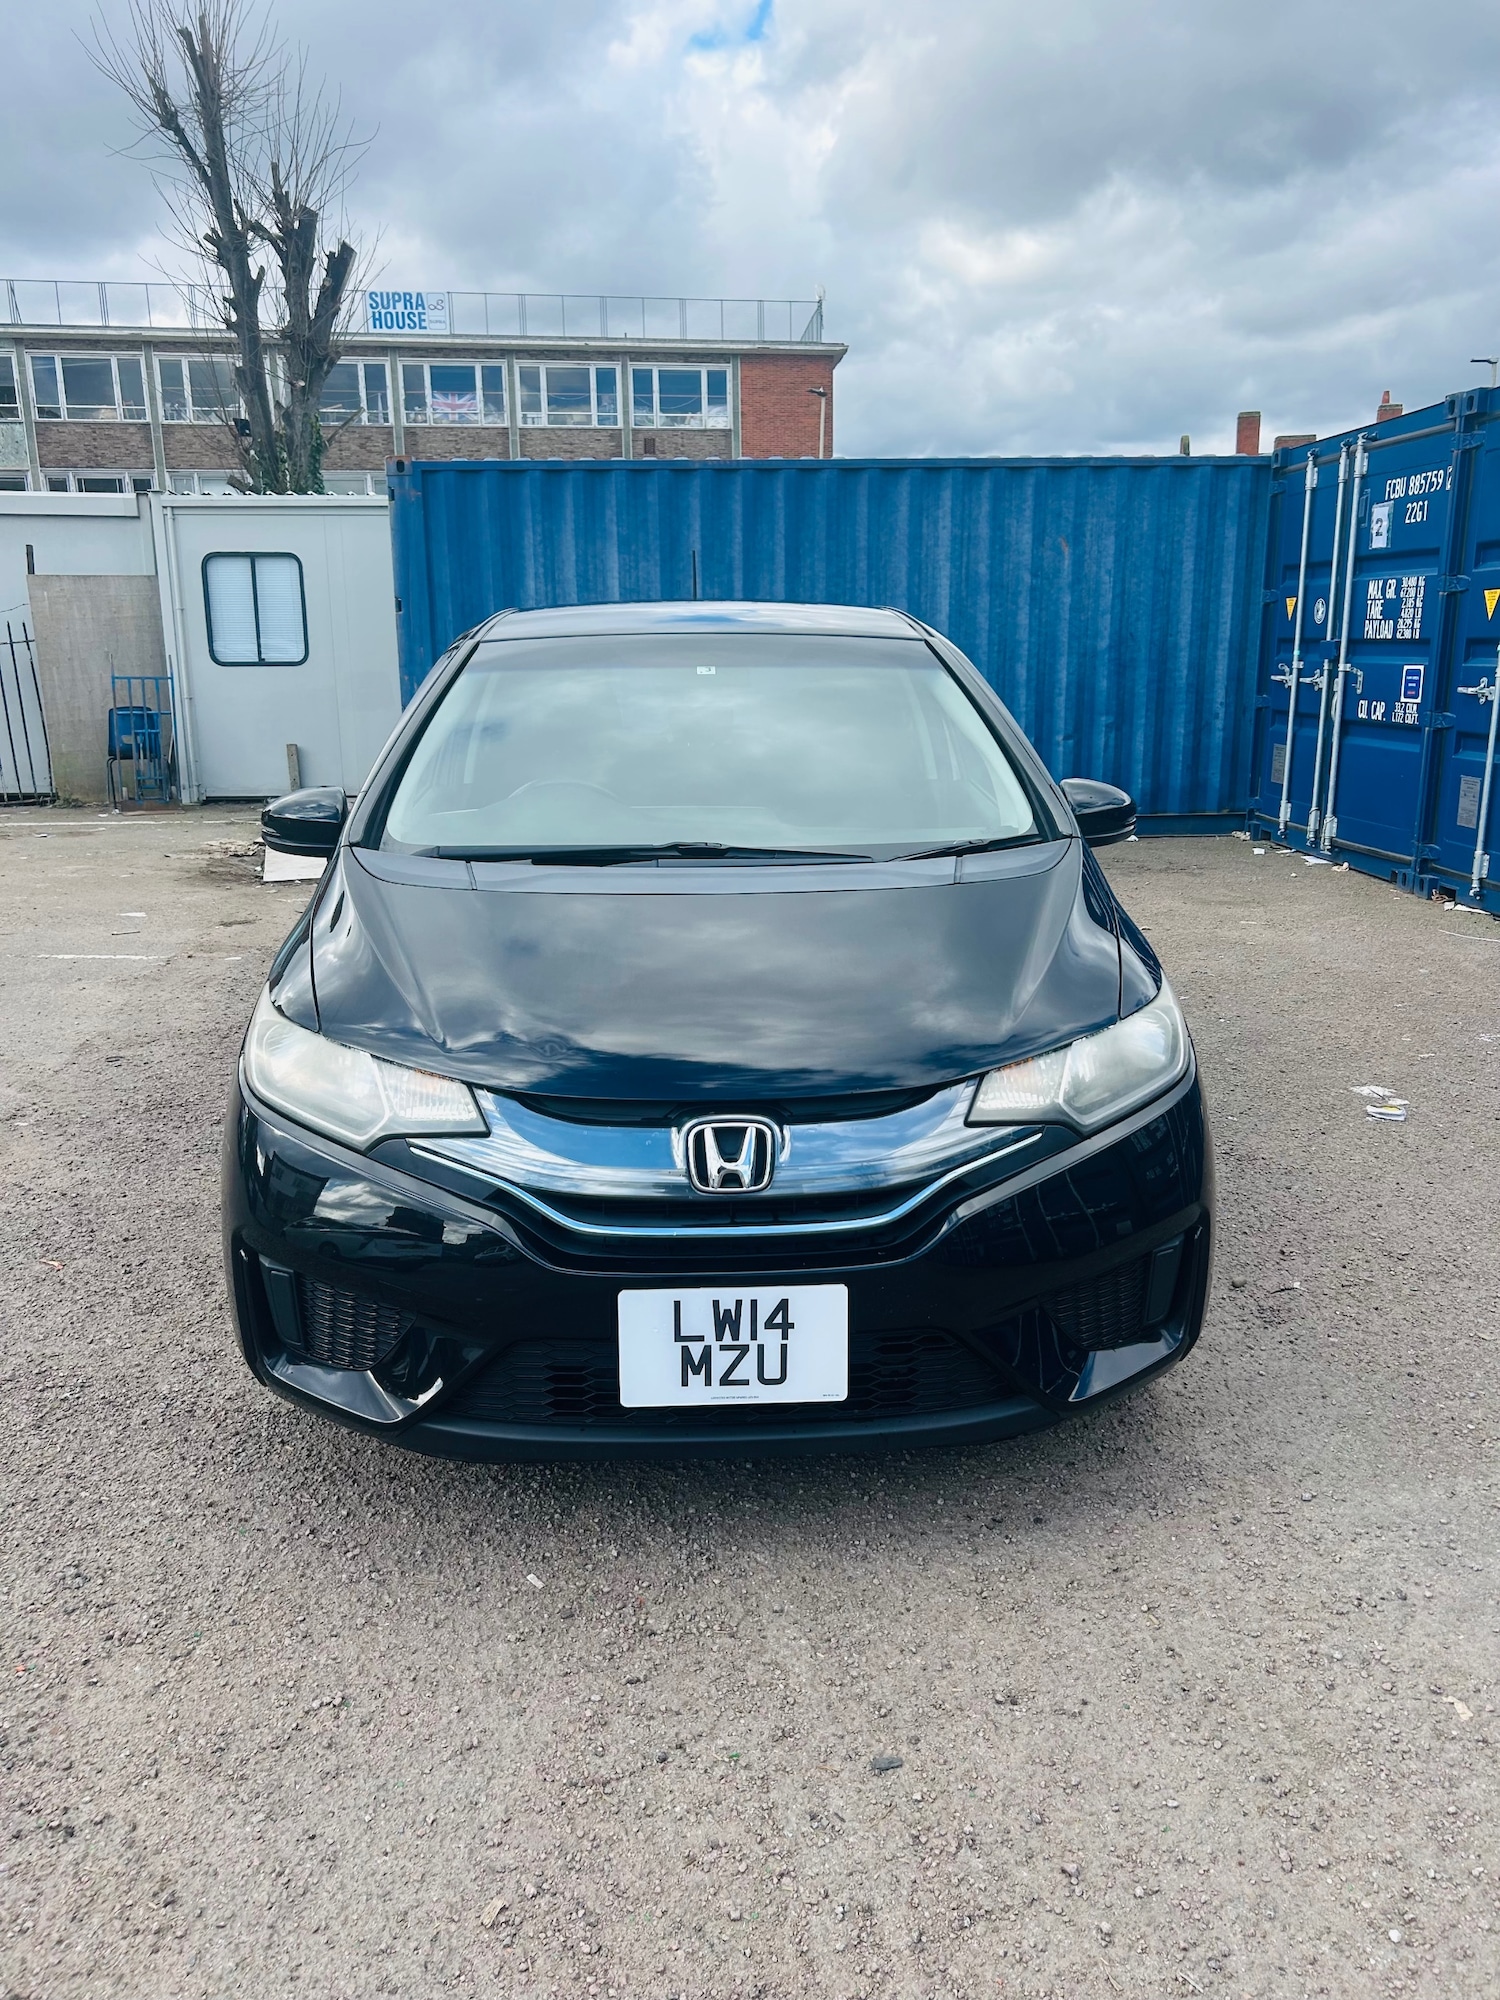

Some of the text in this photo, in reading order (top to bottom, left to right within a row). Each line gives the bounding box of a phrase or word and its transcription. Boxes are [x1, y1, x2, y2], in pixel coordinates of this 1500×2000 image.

[369, 291, 426, 310] SUPRA
[372, 311, 427, 330] HOUSE
[1385, 477, 1407, 500] FCBU
[1408, 470, 1444, 496] 885759
[1405, 500, 1428, 523] 22G1
[1375, 518, 1383, 536] 2
[1367, 600, 1384, 619] TARE
[1364, 620, 1394, 639] PAYLOAD
[1371, 701, 1386, 721] CAP.
[673, 1298, 795, 1342] LW14
[681, 1343, 788, 1387] MZU
